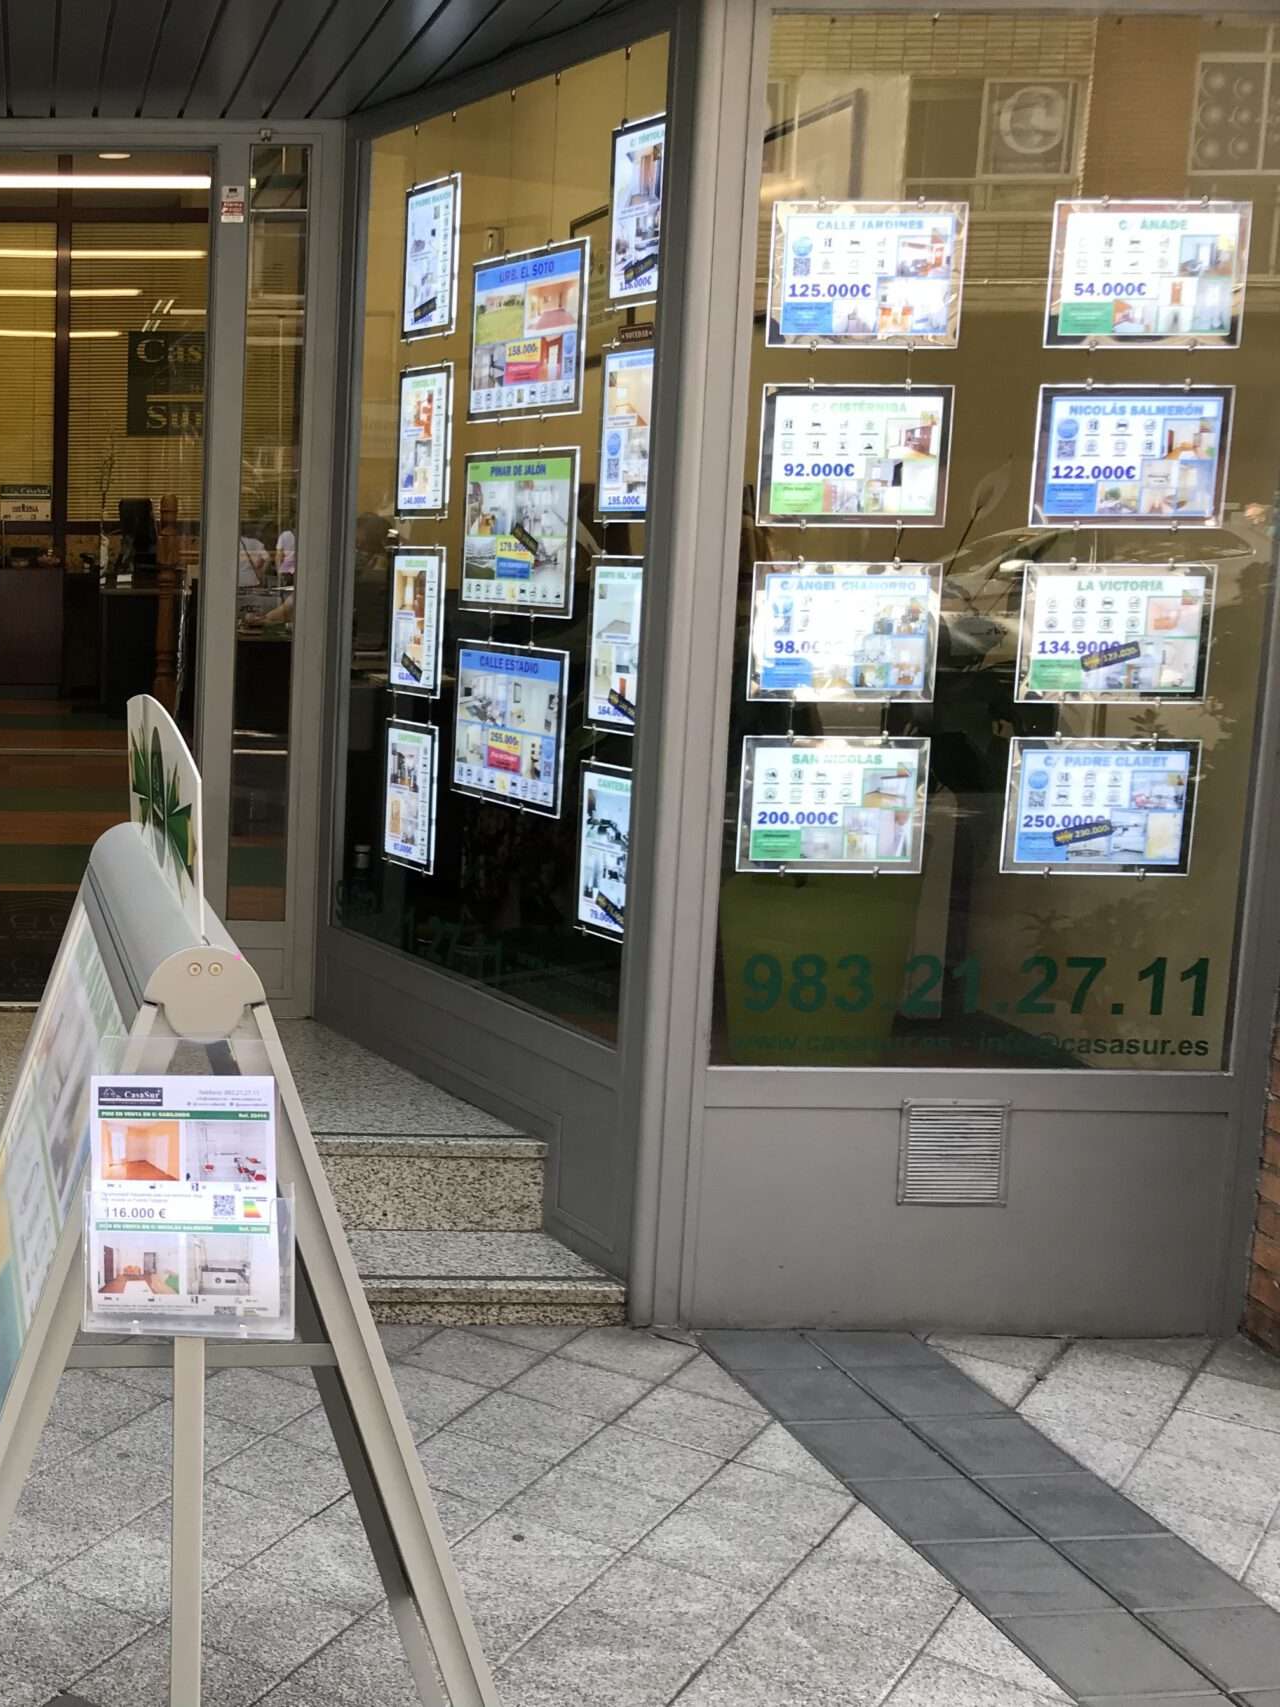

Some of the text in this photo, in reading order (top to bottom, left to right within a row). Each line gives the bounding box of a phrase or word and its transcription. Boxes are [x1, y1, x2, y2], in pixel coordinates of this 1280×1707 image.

[816, 220, 856, 231] CALLE
[531, 260, 555, 277] SOTO
[788, 283, 872, 298] 125.000€
[1073, 282, 1148, 297] 54.000€
[1068, 403, 1204, 416] NICOLÁS SALMERÓN
[783, 463, 856, 477] 92.000€
[1051, 465, 1137, 480] 122.000€
[1077, 579, 1165, 592] LA VICTORIA
[479, 655, 539, 674] CALLE ESTADIO
[791, 754, 819, 765] SAN
[1064, 756, 1113, 768] PADRE
[1115, 756, 1169, 768] CLARET
[757, 811, 840, 825] 200.000€
[742, 953, 1212, 1017] 983.21.27.11
[124, 1090, 161, 1099] CasaSur
[105, 1207, 167, 1219] 116.000 €
